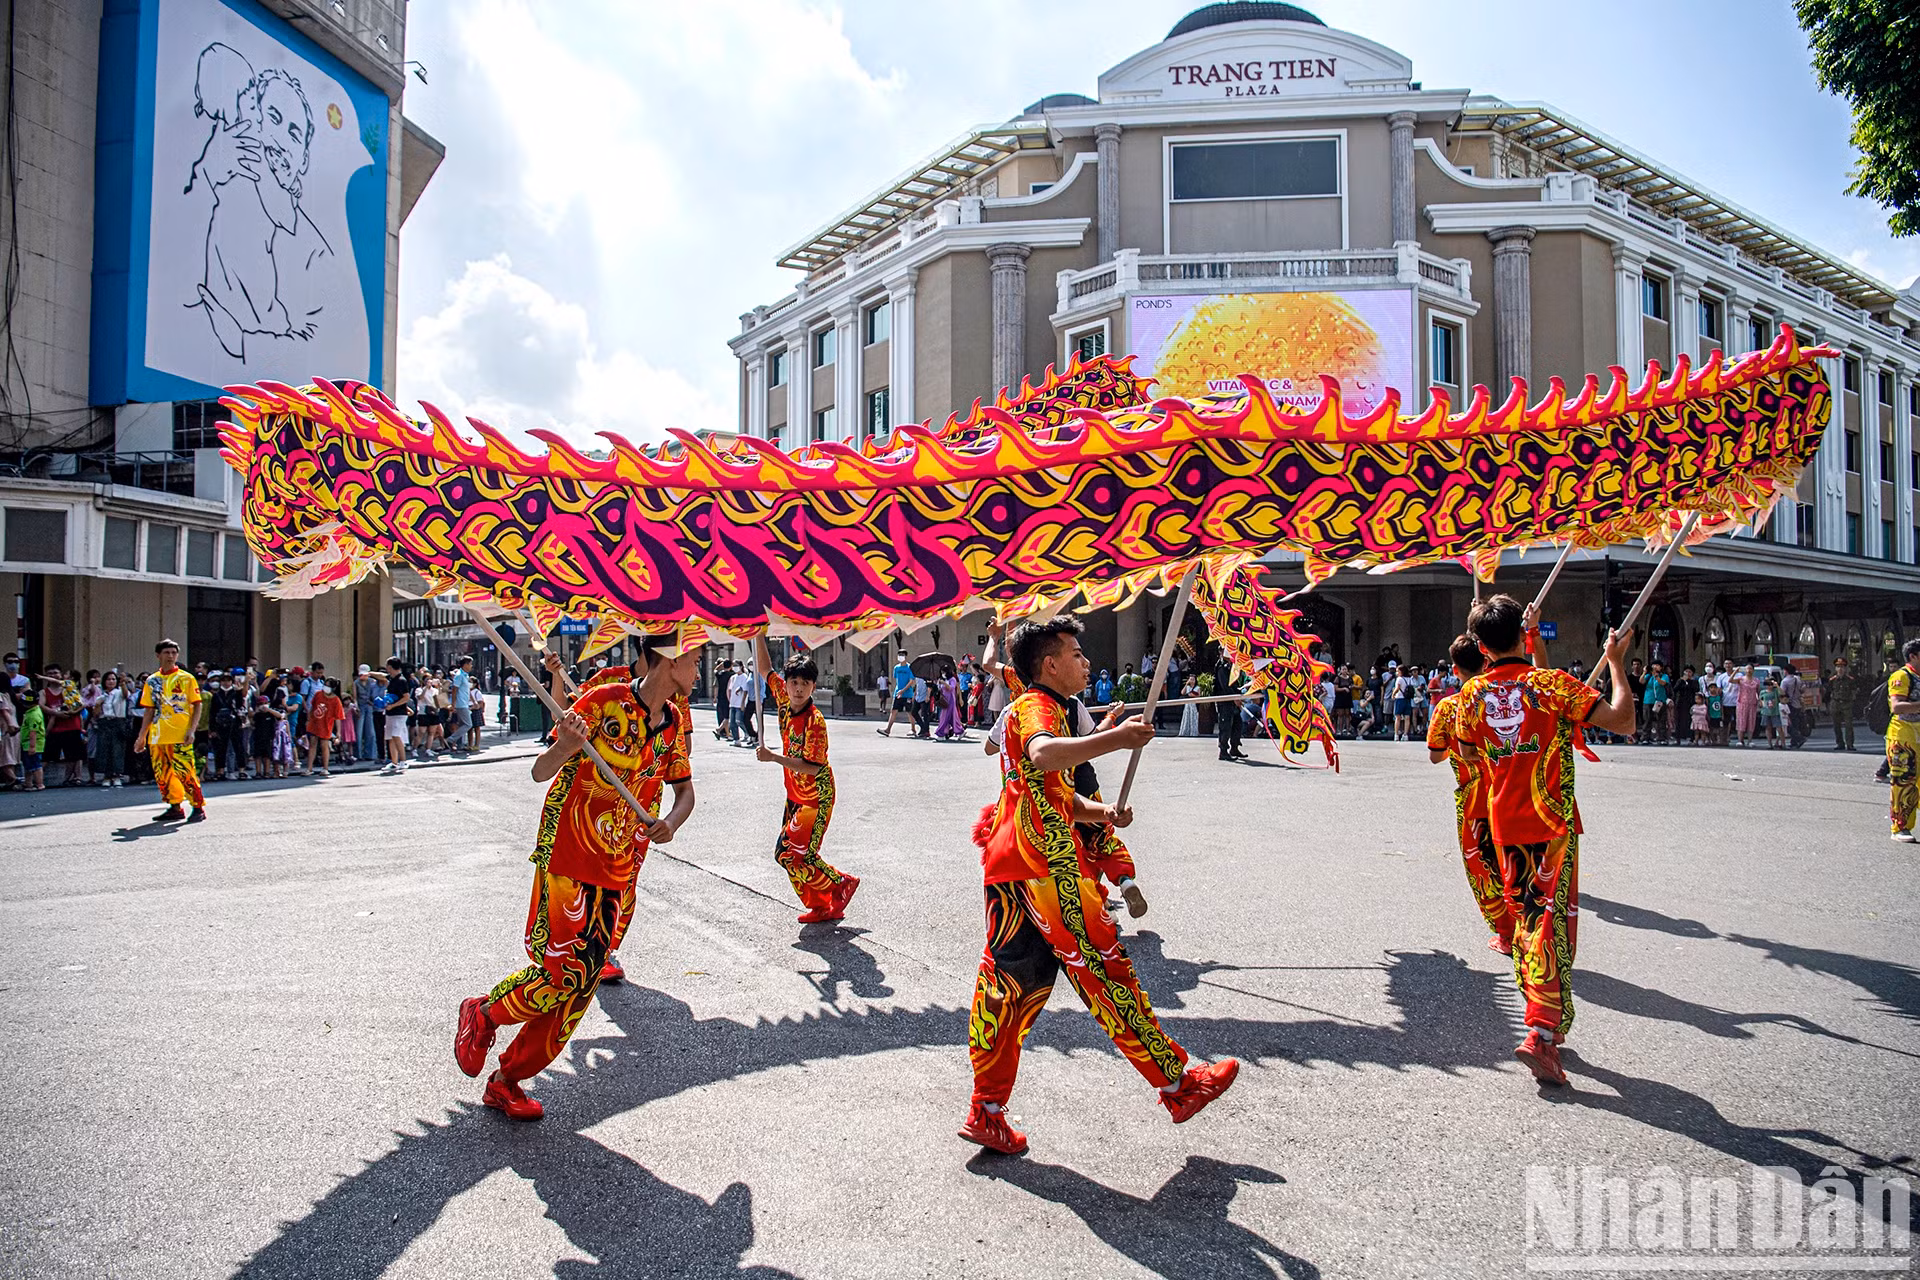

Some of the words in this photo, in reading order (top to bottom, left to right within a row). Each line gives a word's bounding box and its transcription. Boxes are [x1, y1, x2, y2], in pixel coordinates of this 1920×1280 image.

[1168, 62, 1263, 87] TRANG
[1269, 58, 1337, 80] TIEN
[1225, 84, 1280, 97] PLAZA
[1136, 299, 1172, 309] POND'S
[1269, 380, 1279, 390] C
[1282, 380, 1292, 390] &
